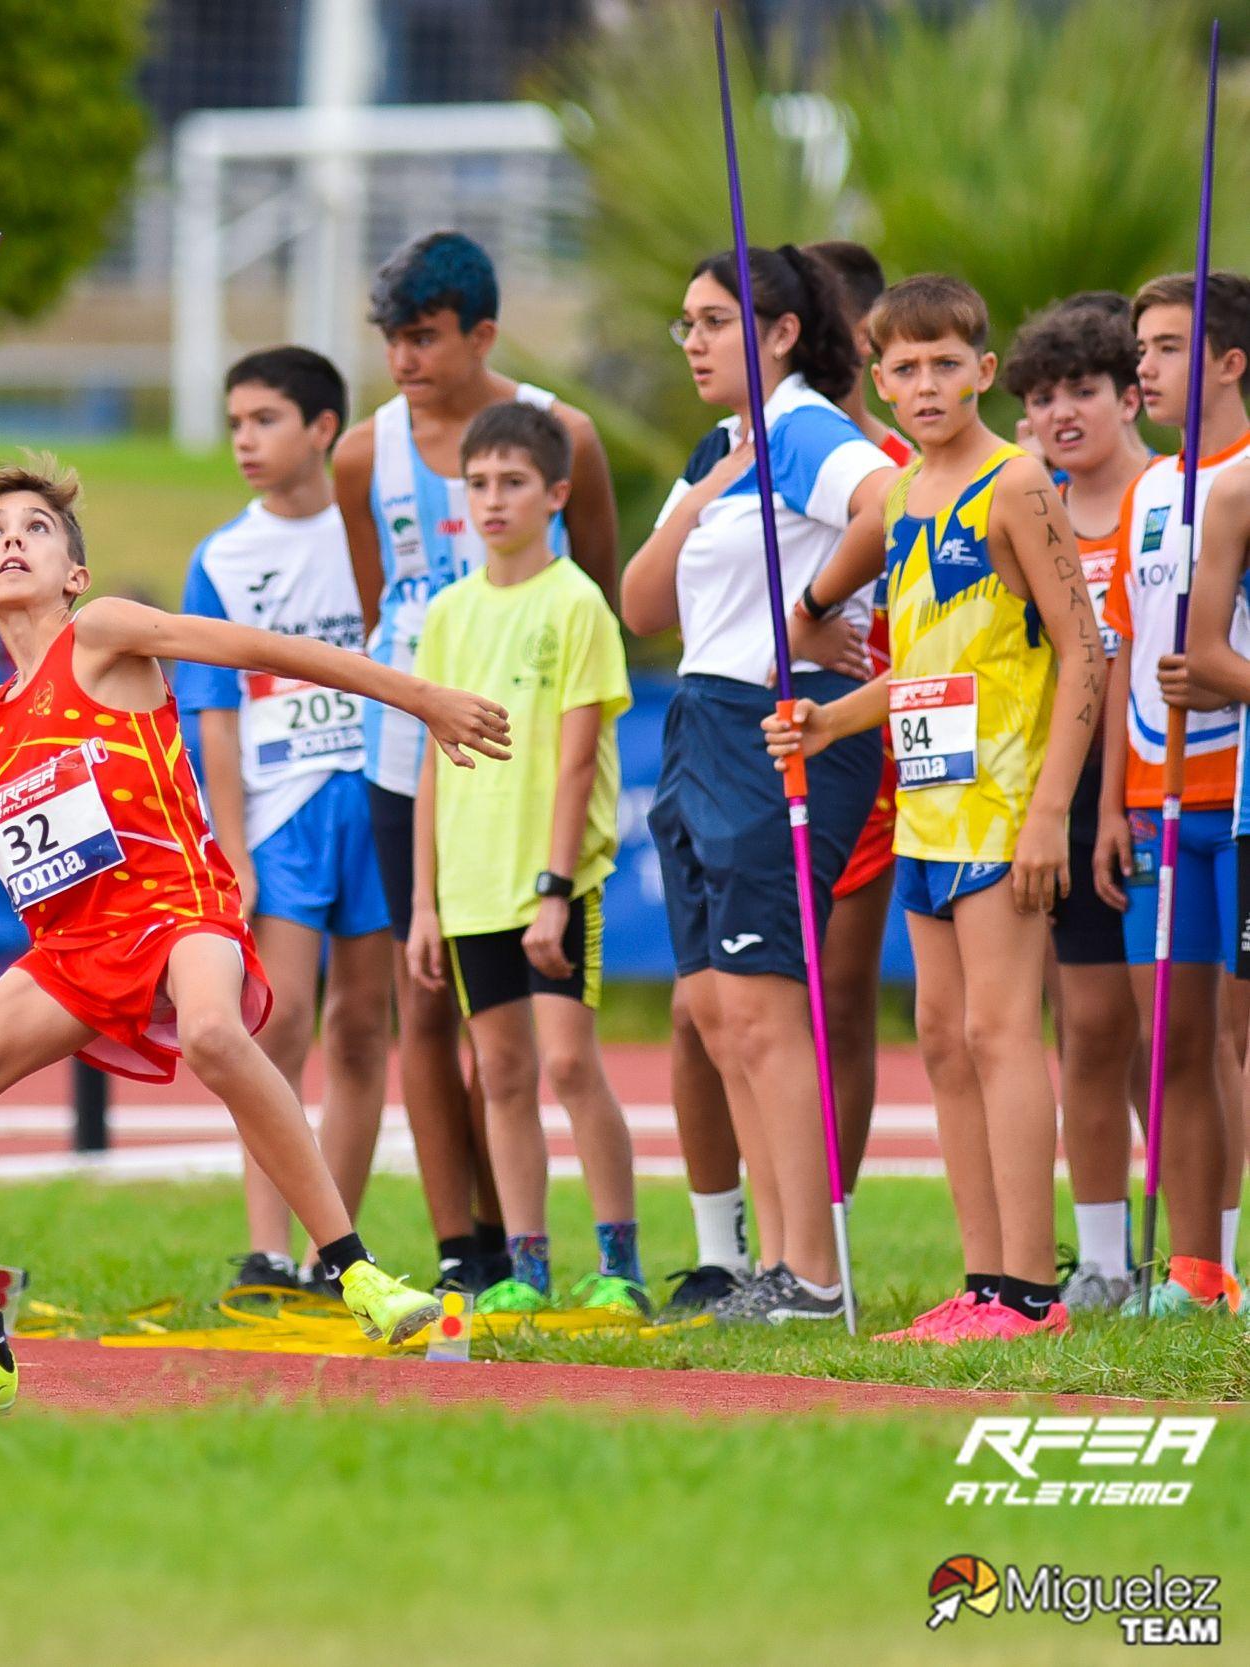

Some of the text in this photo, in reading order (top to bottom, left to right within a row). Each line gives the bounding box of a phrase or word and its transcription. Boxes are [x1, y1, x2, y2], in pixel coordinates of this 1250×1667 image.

[285, 691, 357, 729] 205
[901, 716, 932, 752] 84
[2, 813, 60, 866] 32
